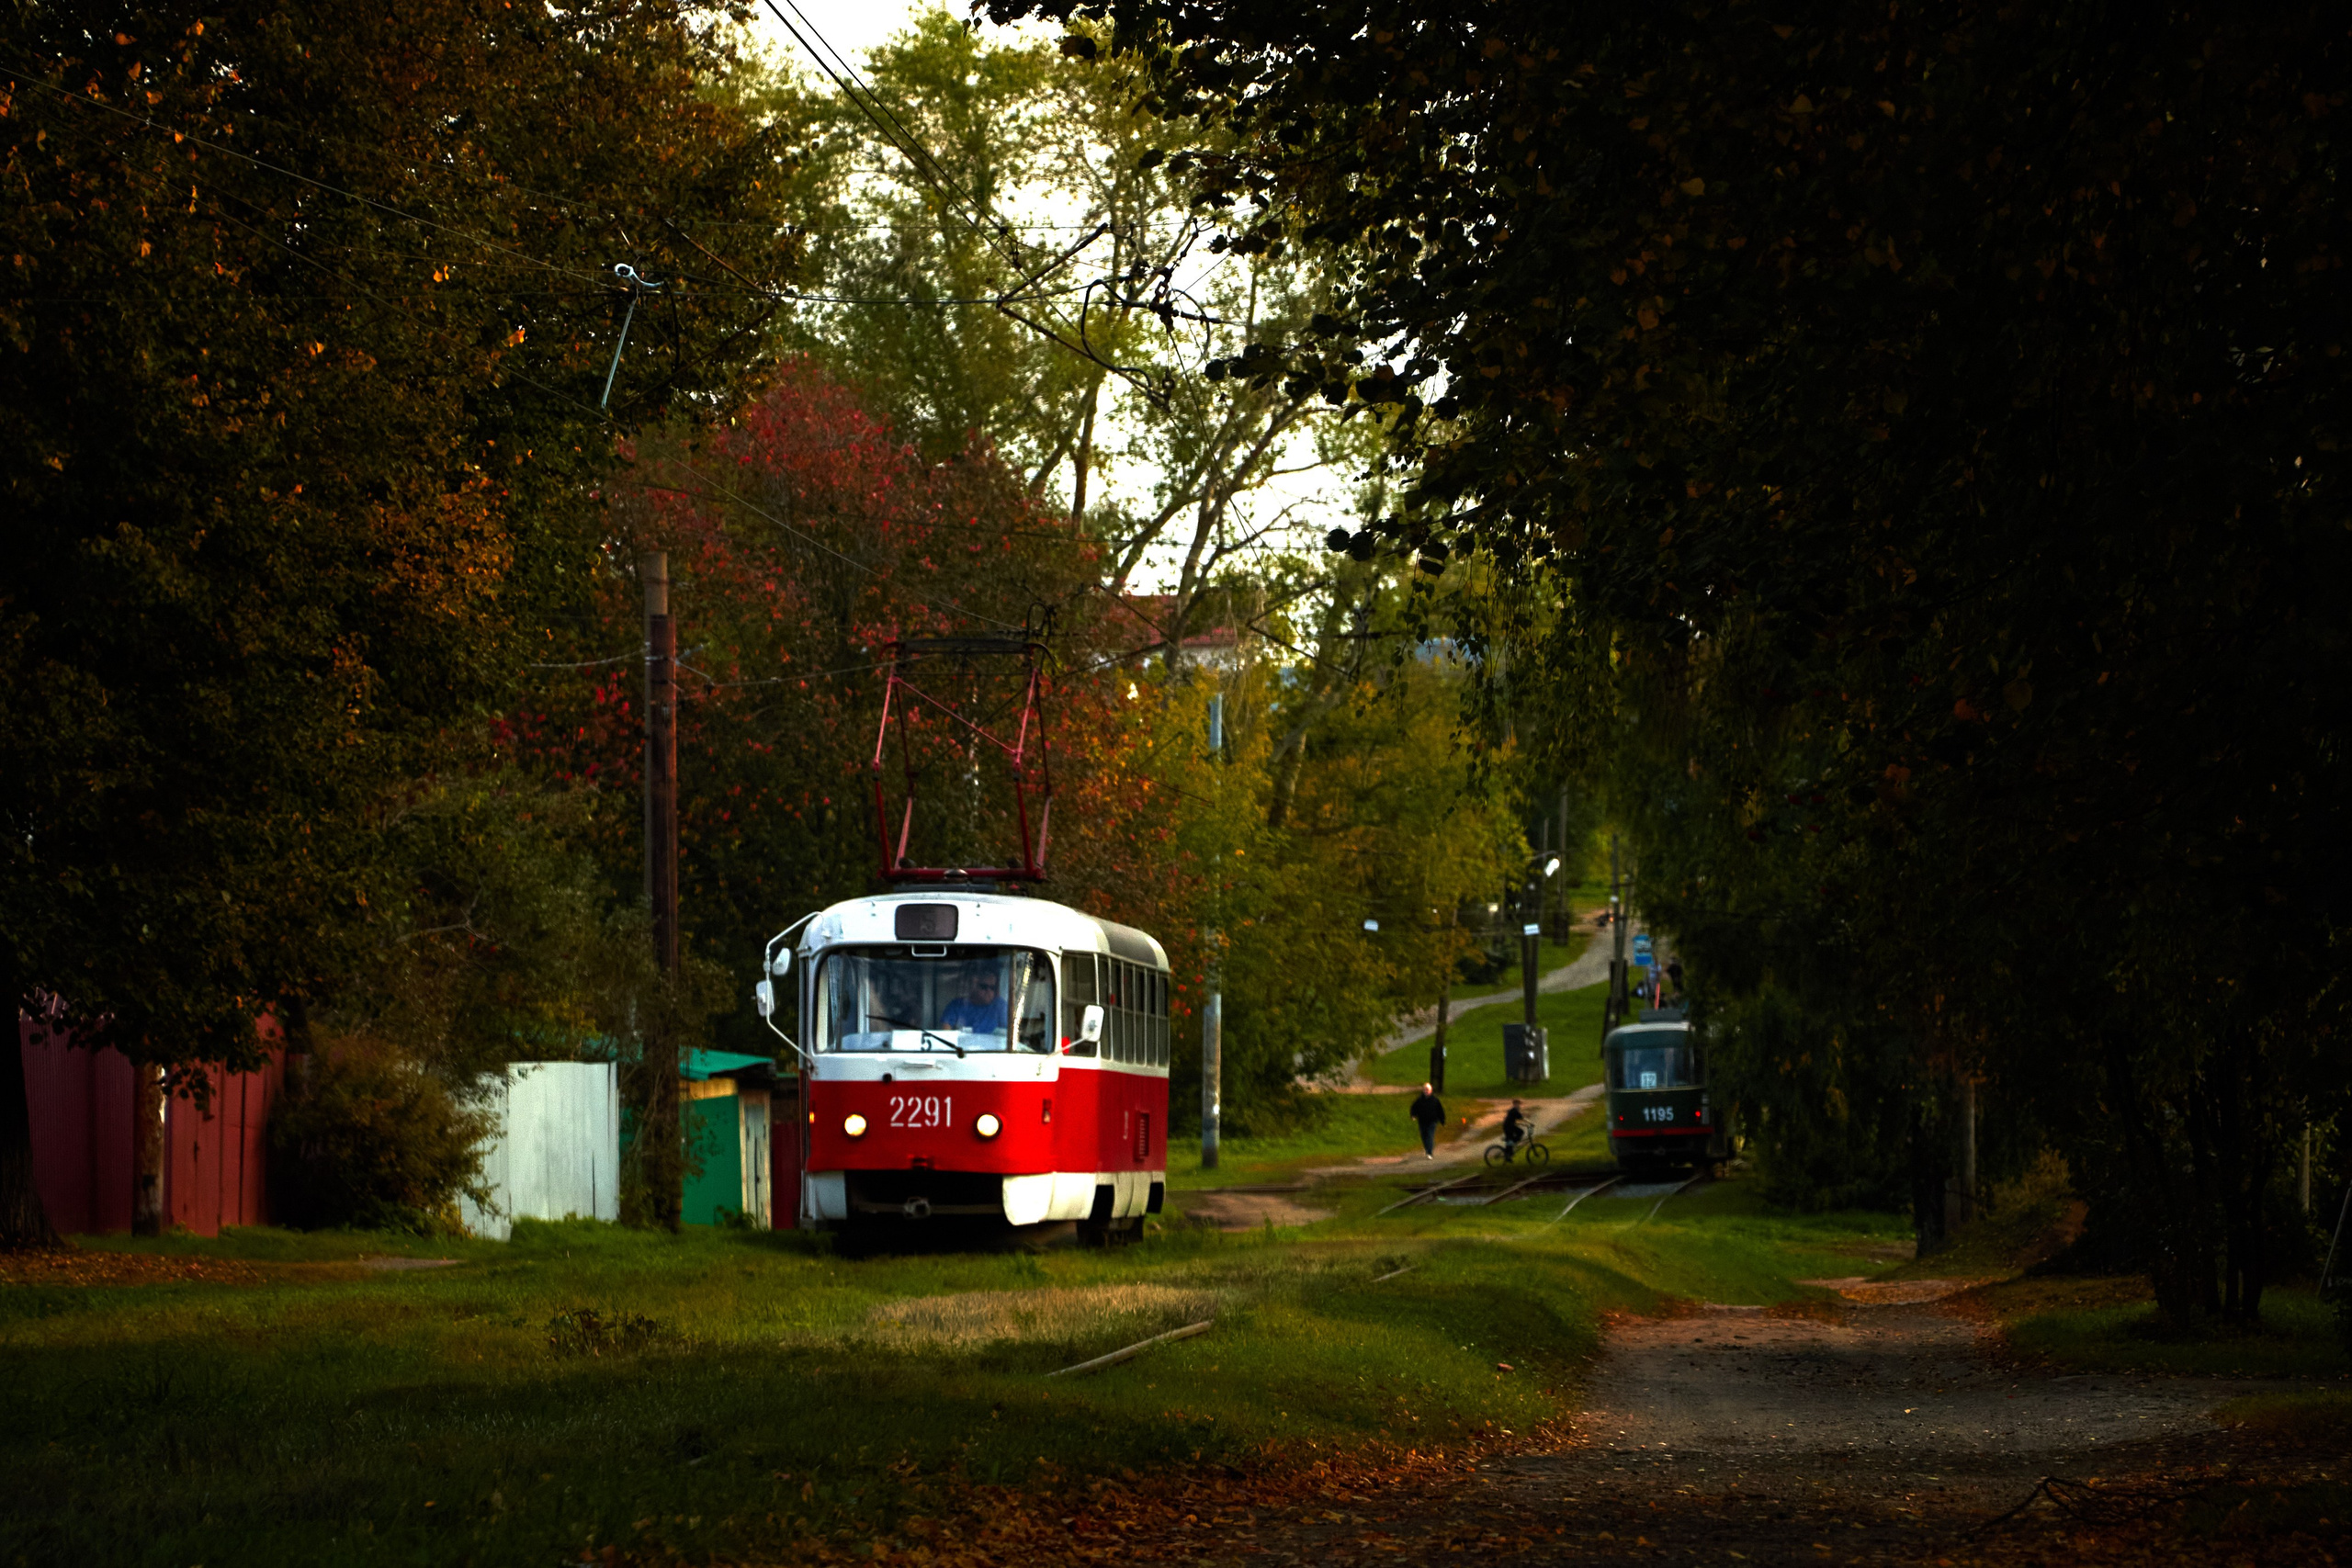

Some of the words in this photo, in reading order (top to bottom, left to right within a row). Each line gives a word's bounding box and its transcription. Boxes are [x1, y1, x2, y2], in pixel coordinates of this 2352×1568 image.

[921, 1032, 933, 1052] 5
[889, 1095, 952, 1129] 2291
[1643, 1105, 1675, 1122] 1195
